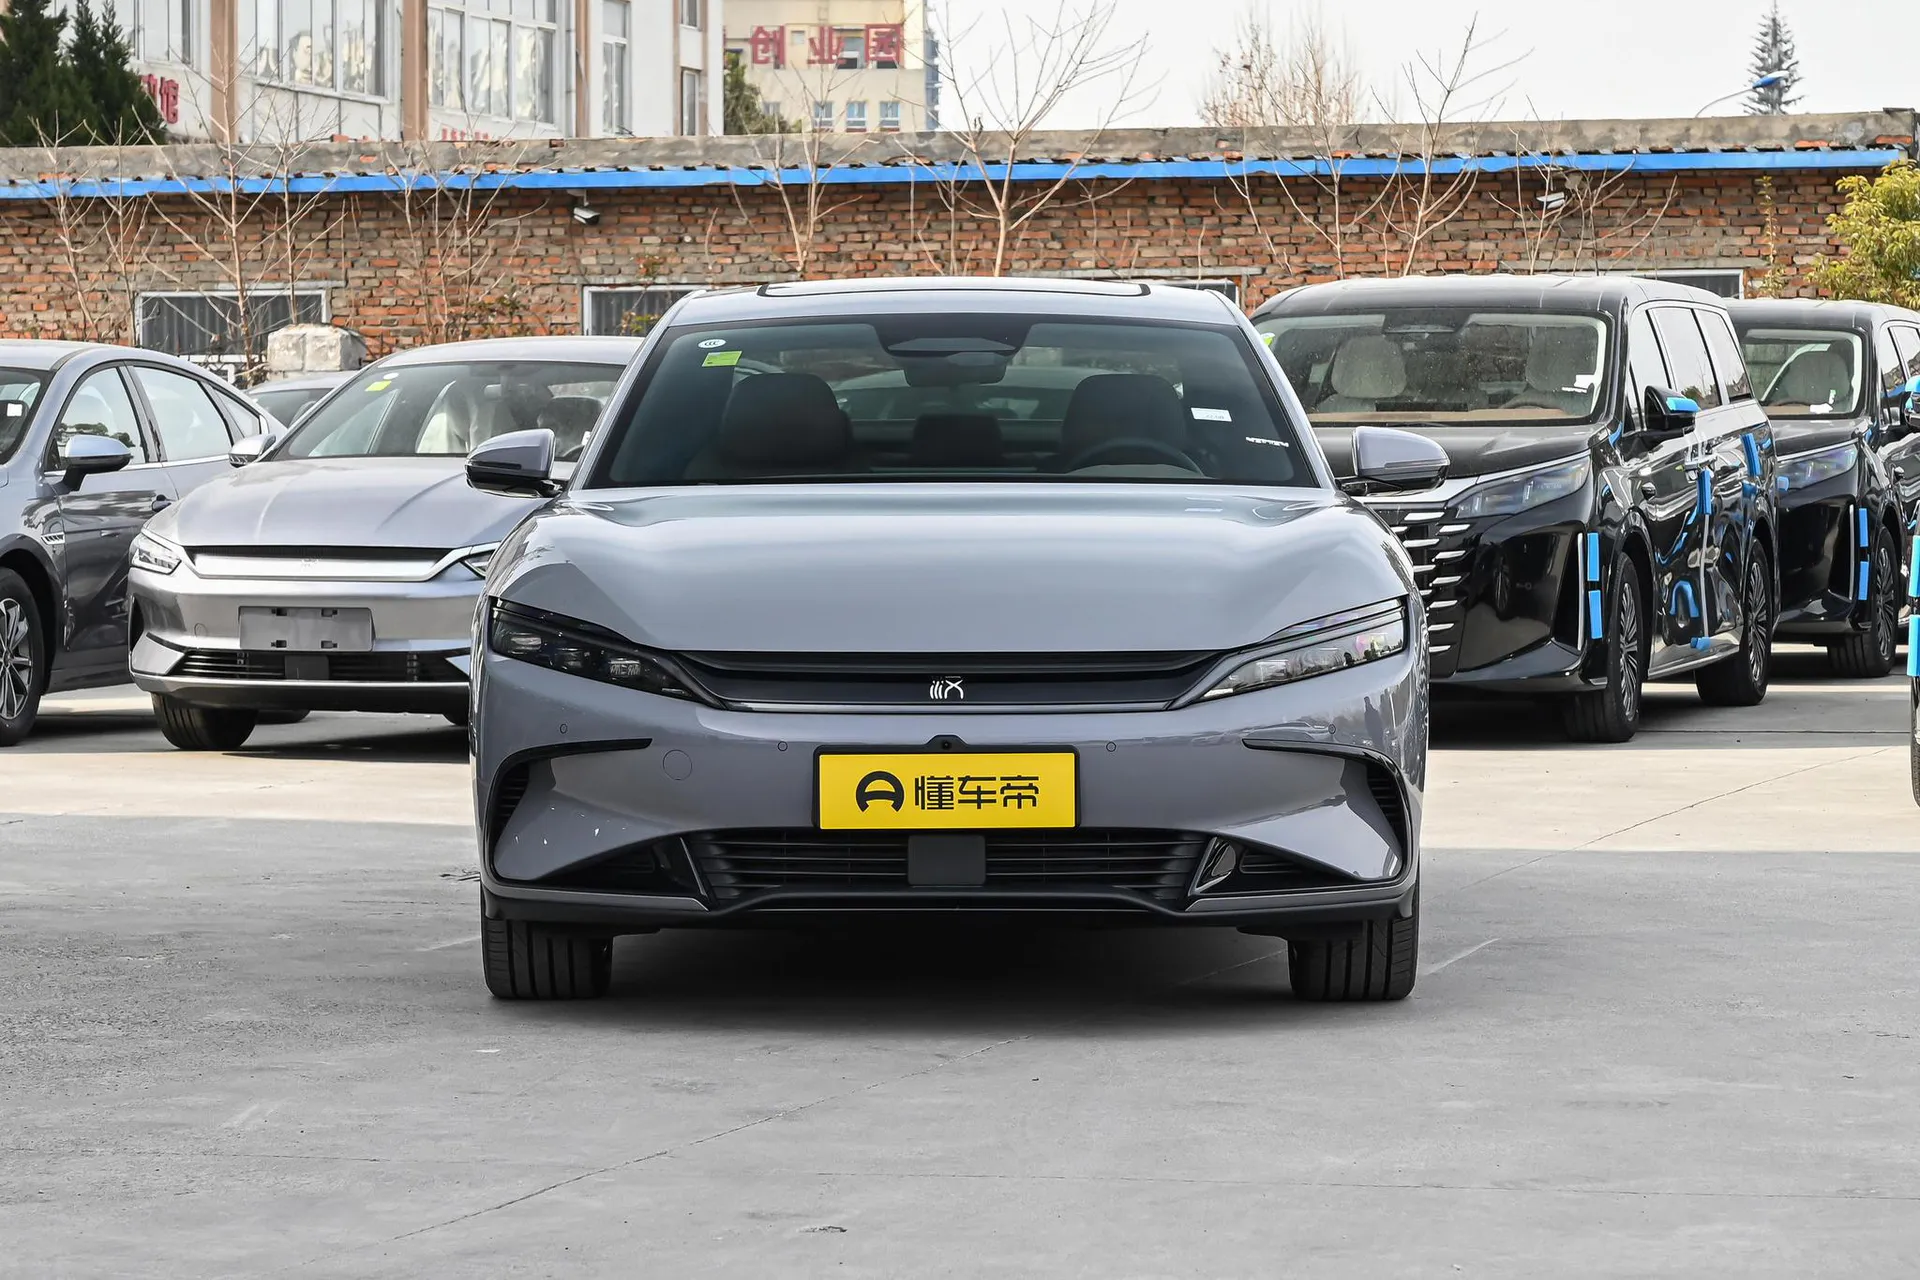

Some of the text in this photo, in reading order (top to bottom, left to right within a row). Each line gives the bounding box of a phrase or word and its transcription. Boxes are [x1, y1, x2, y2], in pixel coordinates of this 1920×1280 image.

[749, 23, 904, 67] 创业园
[914, 774, 1040, 810] 懂车帝
